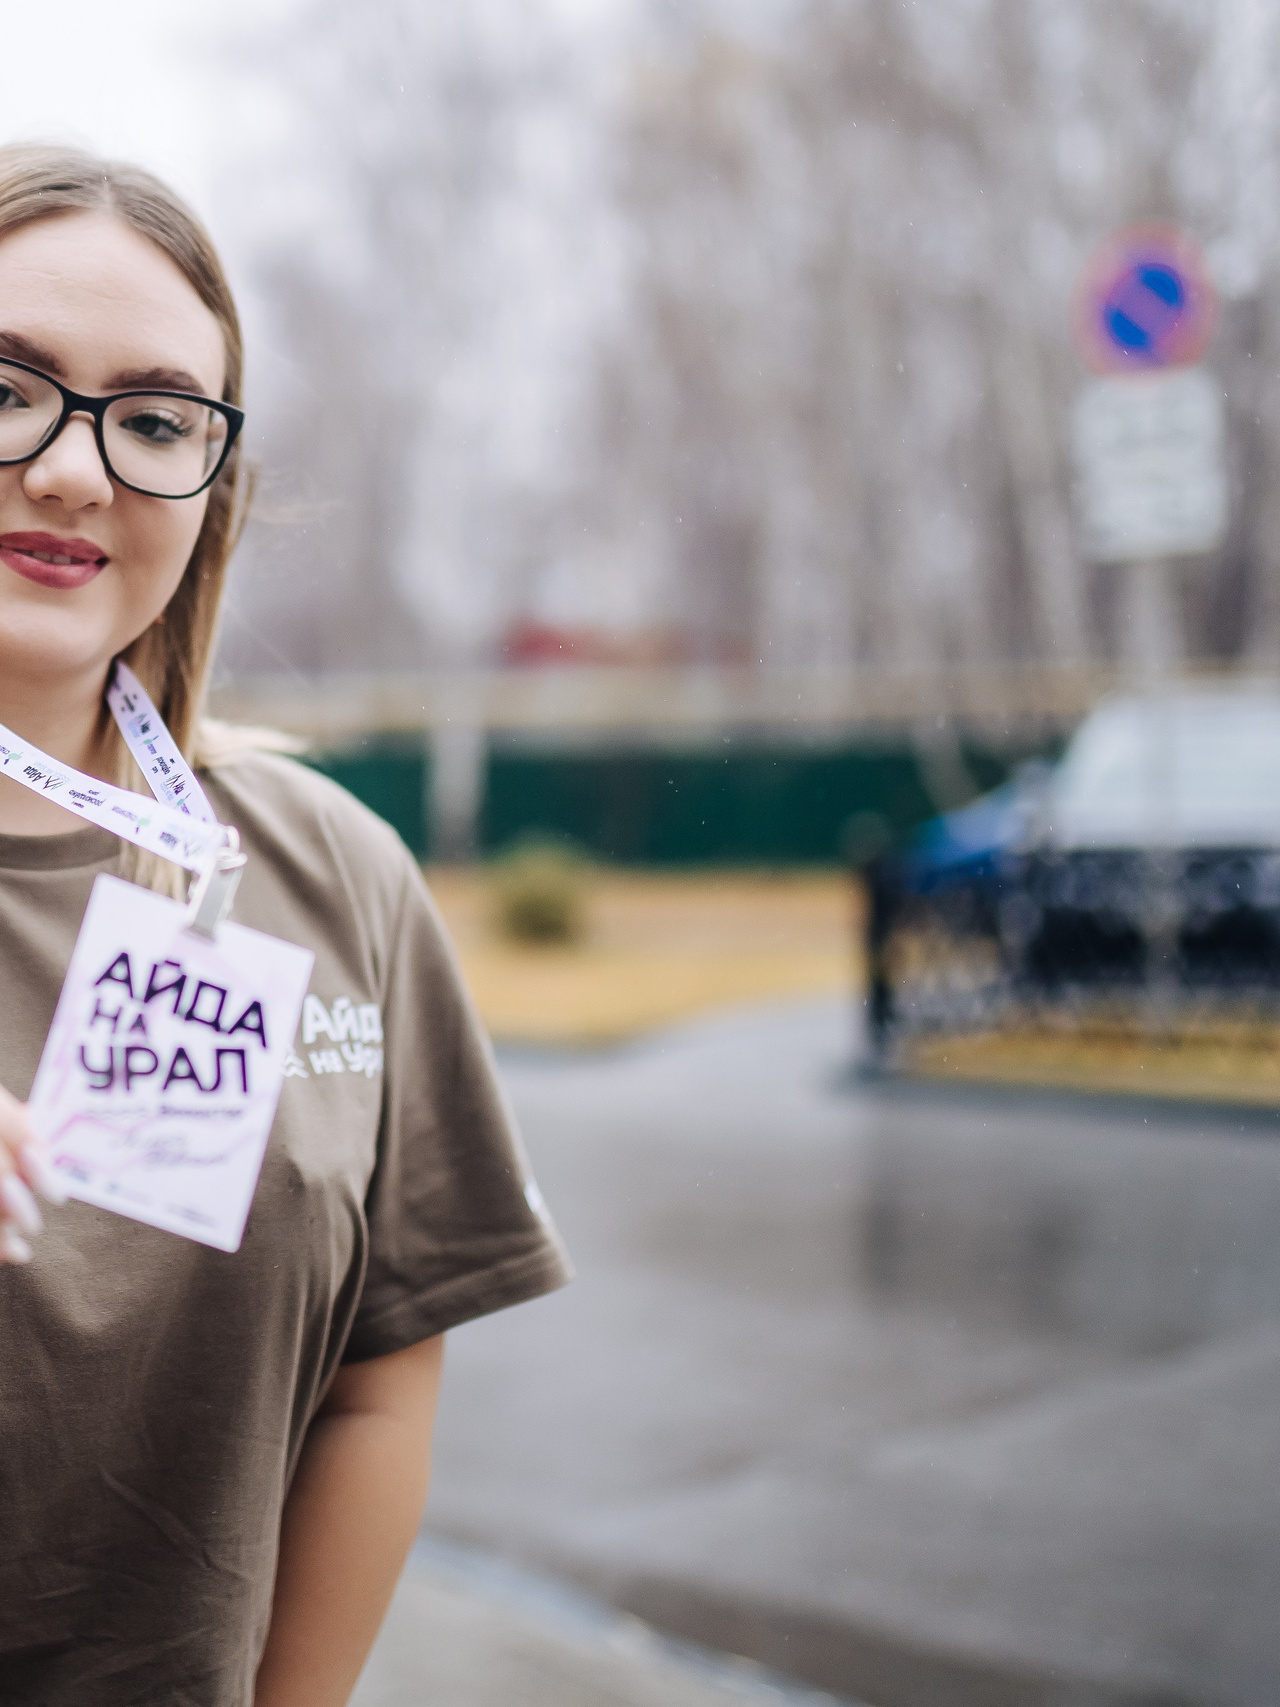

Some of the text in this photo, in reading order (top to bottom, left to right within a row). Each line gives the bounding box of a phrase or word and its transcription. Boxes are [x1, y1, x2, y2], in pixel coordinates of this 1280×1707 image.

[89, 998, 147, 1037] НА
[93, 951, 267, 1049] АЙДА
[79, 1044, 249, 1094] УРАЛ
